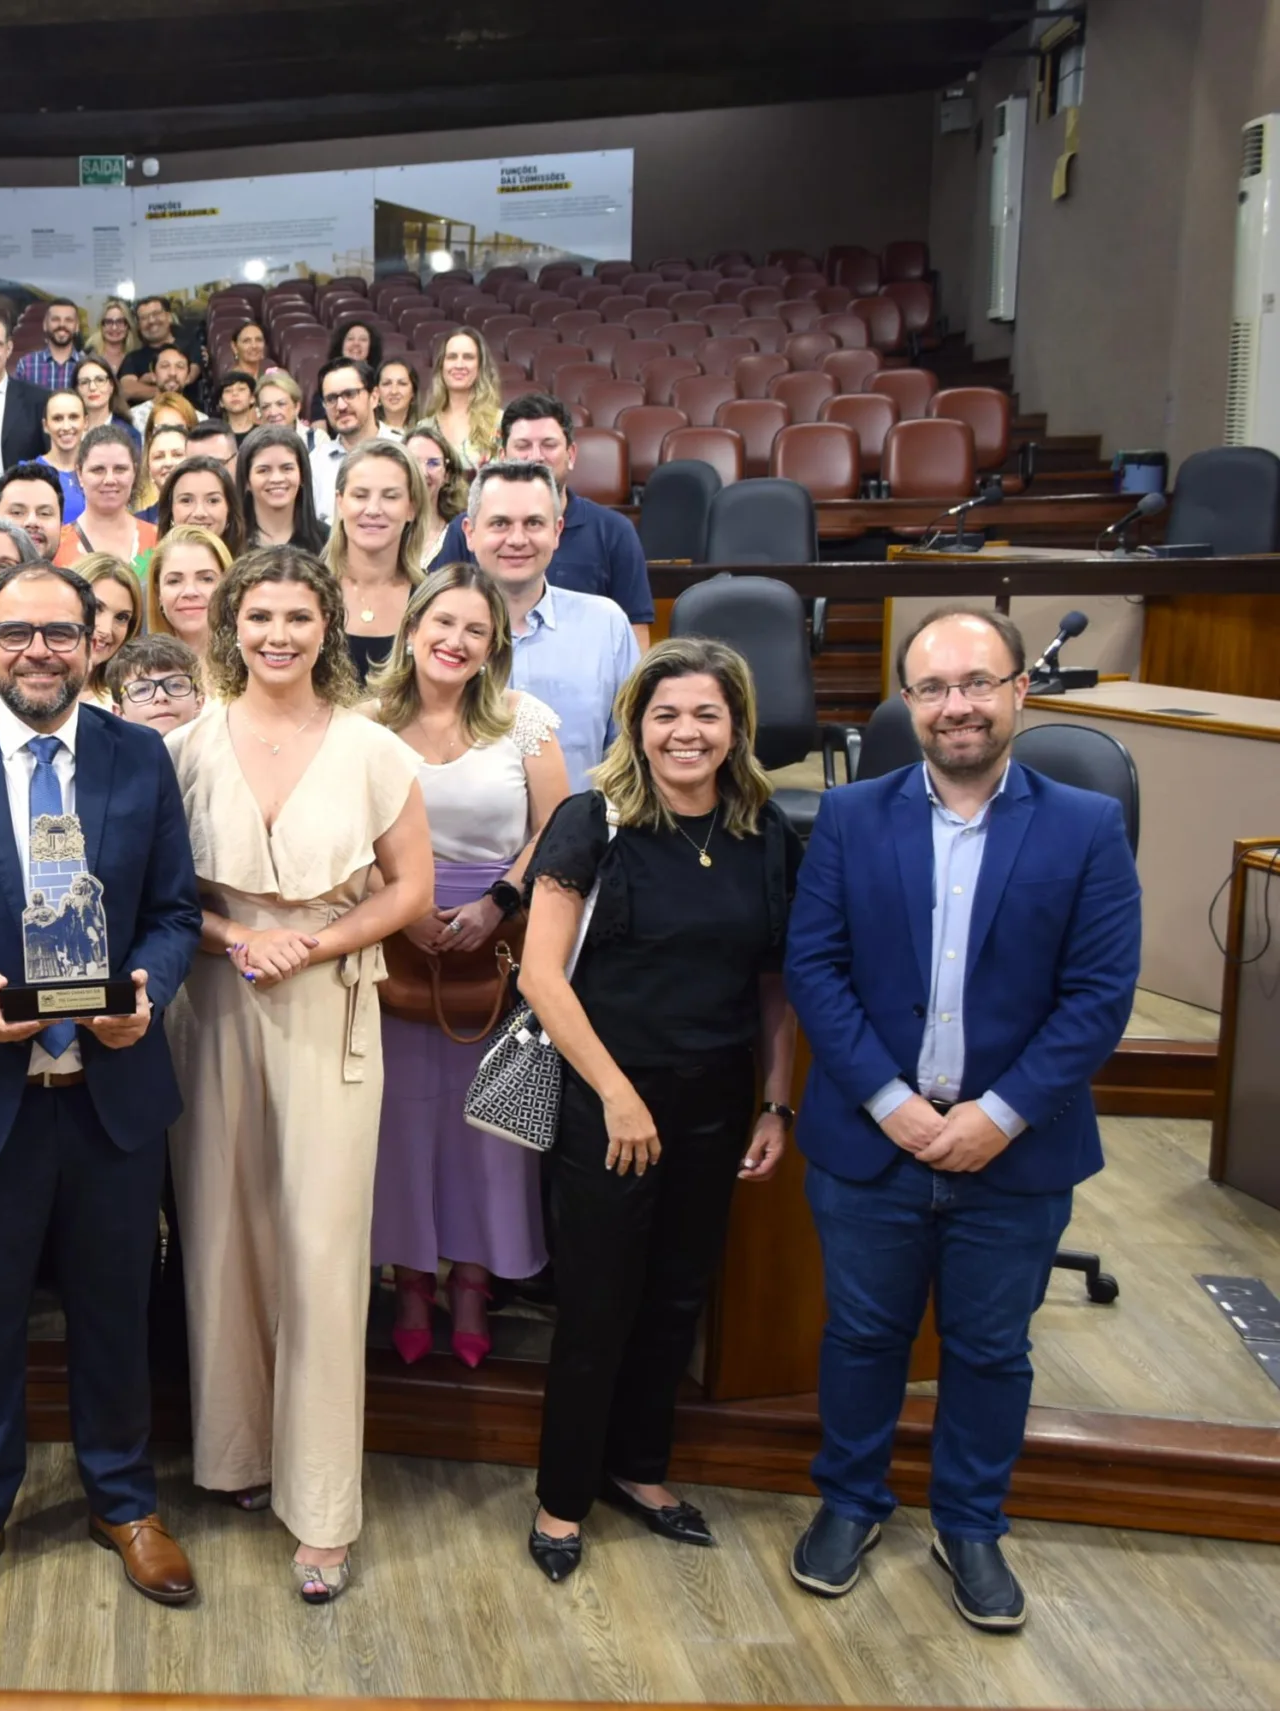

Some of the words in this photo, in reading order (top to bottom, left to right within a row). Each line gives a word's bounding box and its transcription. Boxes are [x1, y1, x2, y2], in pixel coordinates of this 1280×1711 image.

[500, 165, 538, 175] FUNÇÕES
[500, 175, 517, 184] DAS
[519, 172, 566, 183] COMISSÕES
[501, 183, 569, 192] PARLAMENTARES
[148, 201, 182, 211] FUNÇÕES
